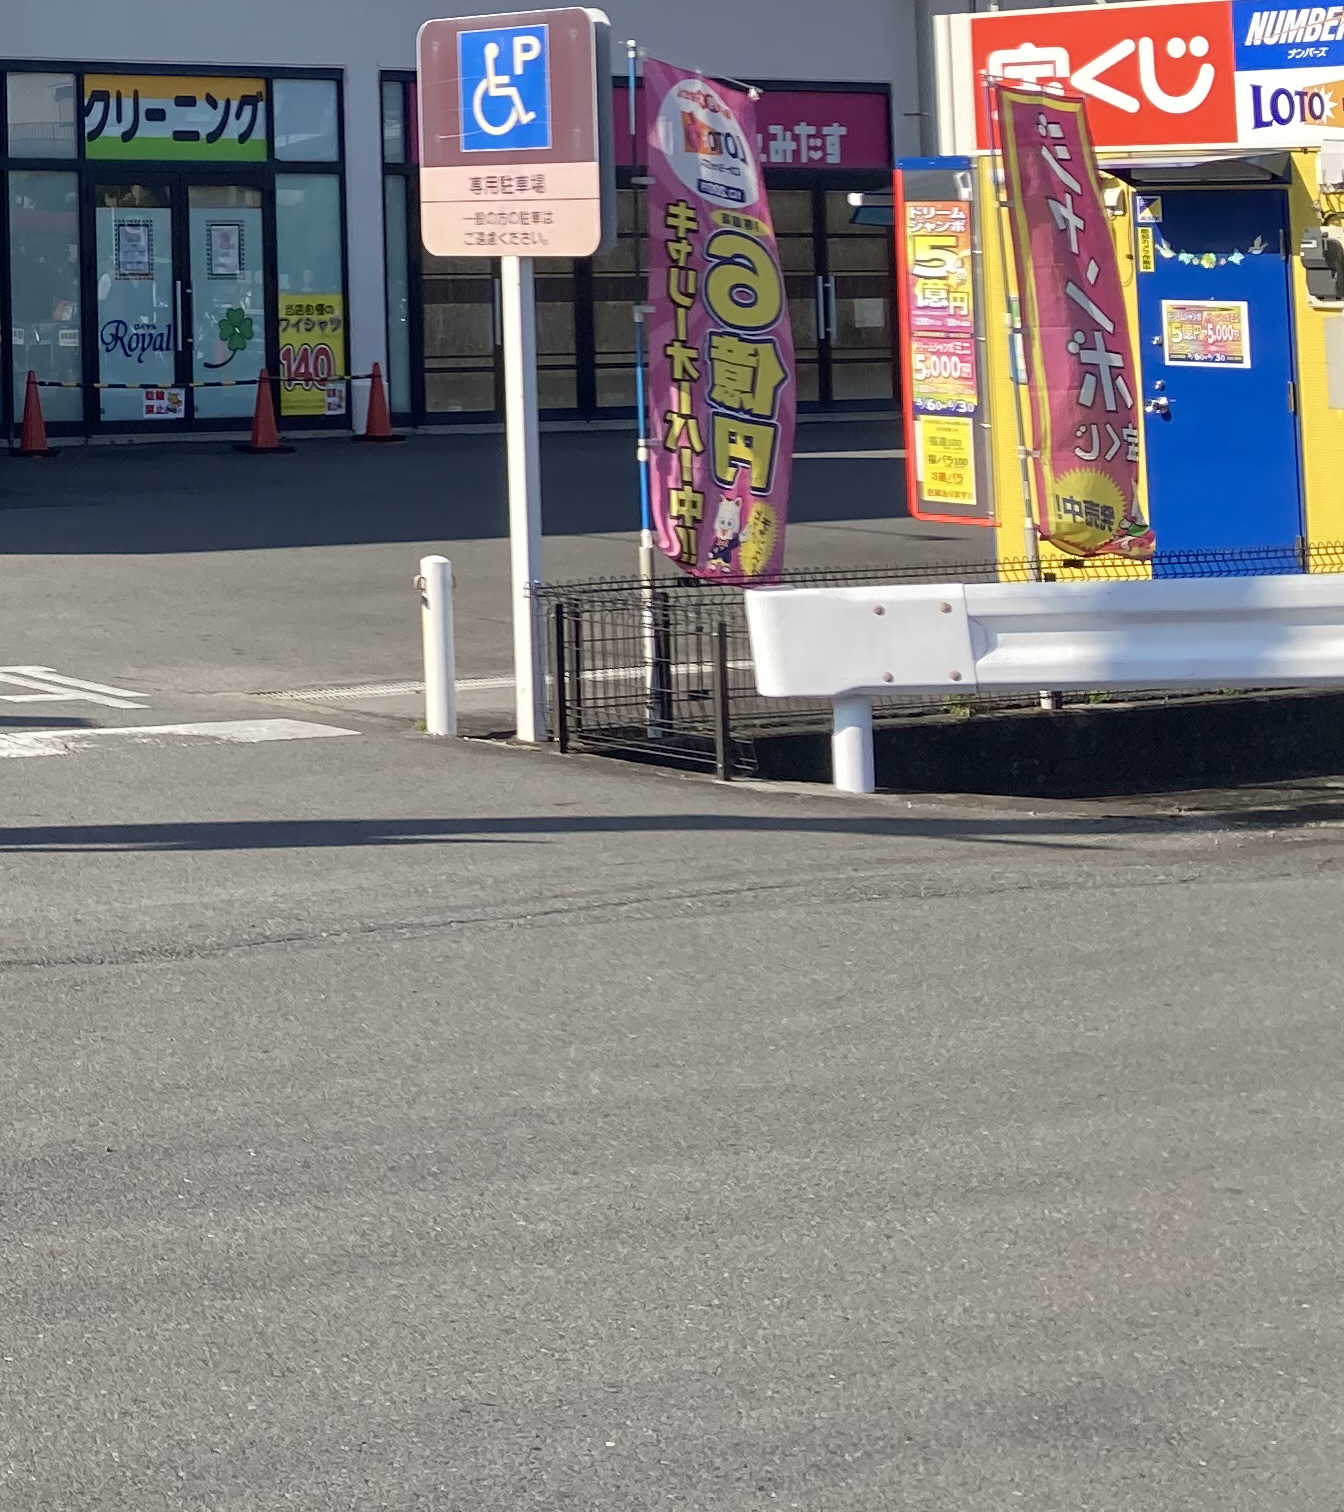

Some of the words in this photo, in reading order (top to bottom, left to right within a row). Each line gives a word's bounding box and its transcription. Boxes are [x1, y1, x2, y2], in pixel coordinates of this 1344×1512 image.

[513, 35, 542, 76] P
[1287, 46, 1330, 60] ナンバーズ
[83, 88, 264, 145] クリーニング
[1249, 83, 1325, 130] LOTO
[469, 173, 547, 196] 専用駐車場
[909, 206, 967, 219] ドリーム
[909, 220, 966, 233] ジャンボ
[100, 319, 173, 364] Royal
